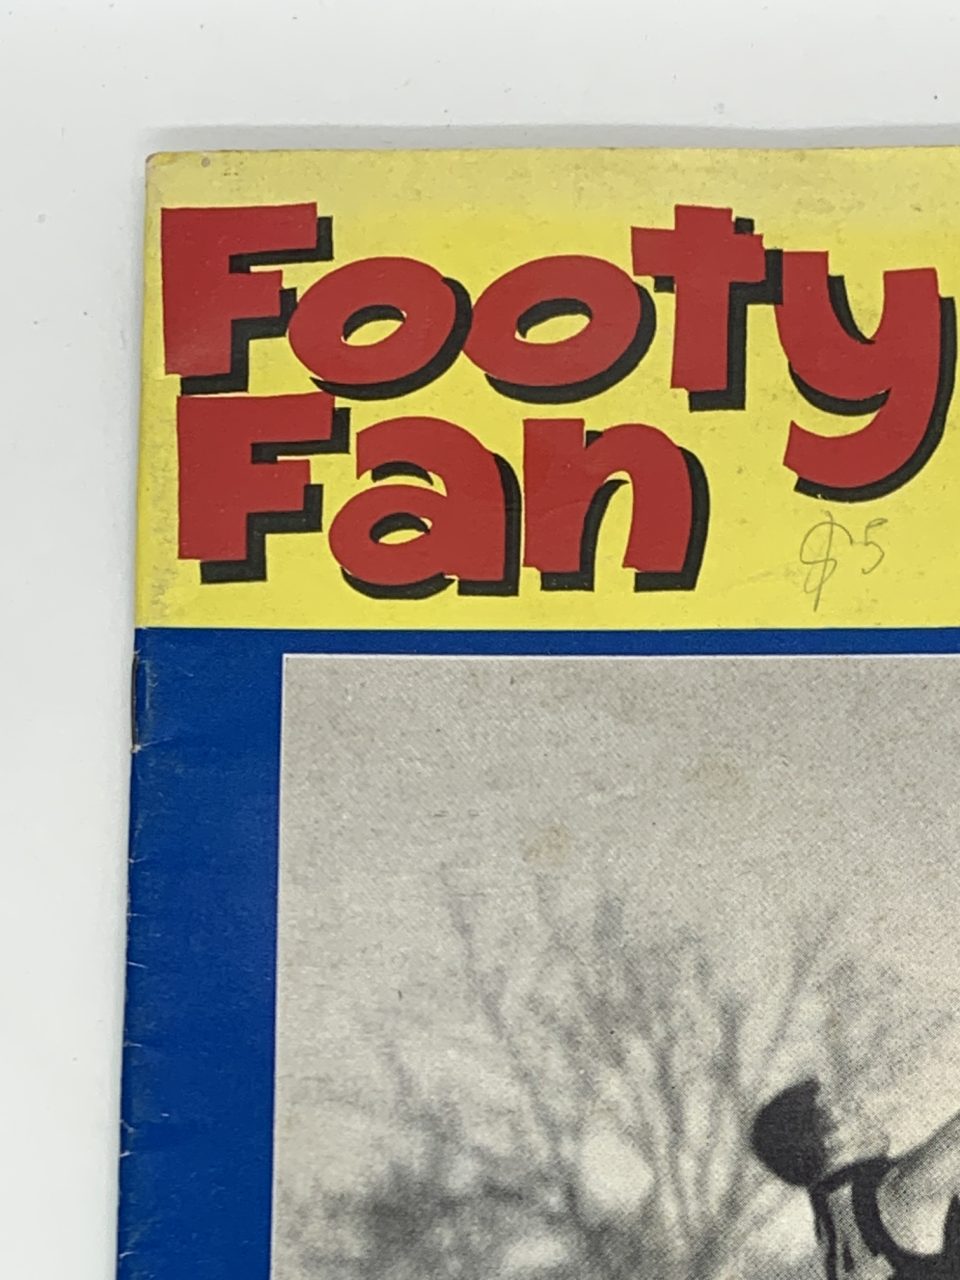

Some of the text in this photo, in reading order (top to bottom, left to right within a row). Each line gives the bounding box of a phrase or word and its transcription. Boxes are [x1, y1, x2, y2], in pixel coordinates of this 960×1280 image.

[160, 202, 956, 503] Footy
[176, 392, 711, 600] Fan
[800, 509, 888, 612] $5
